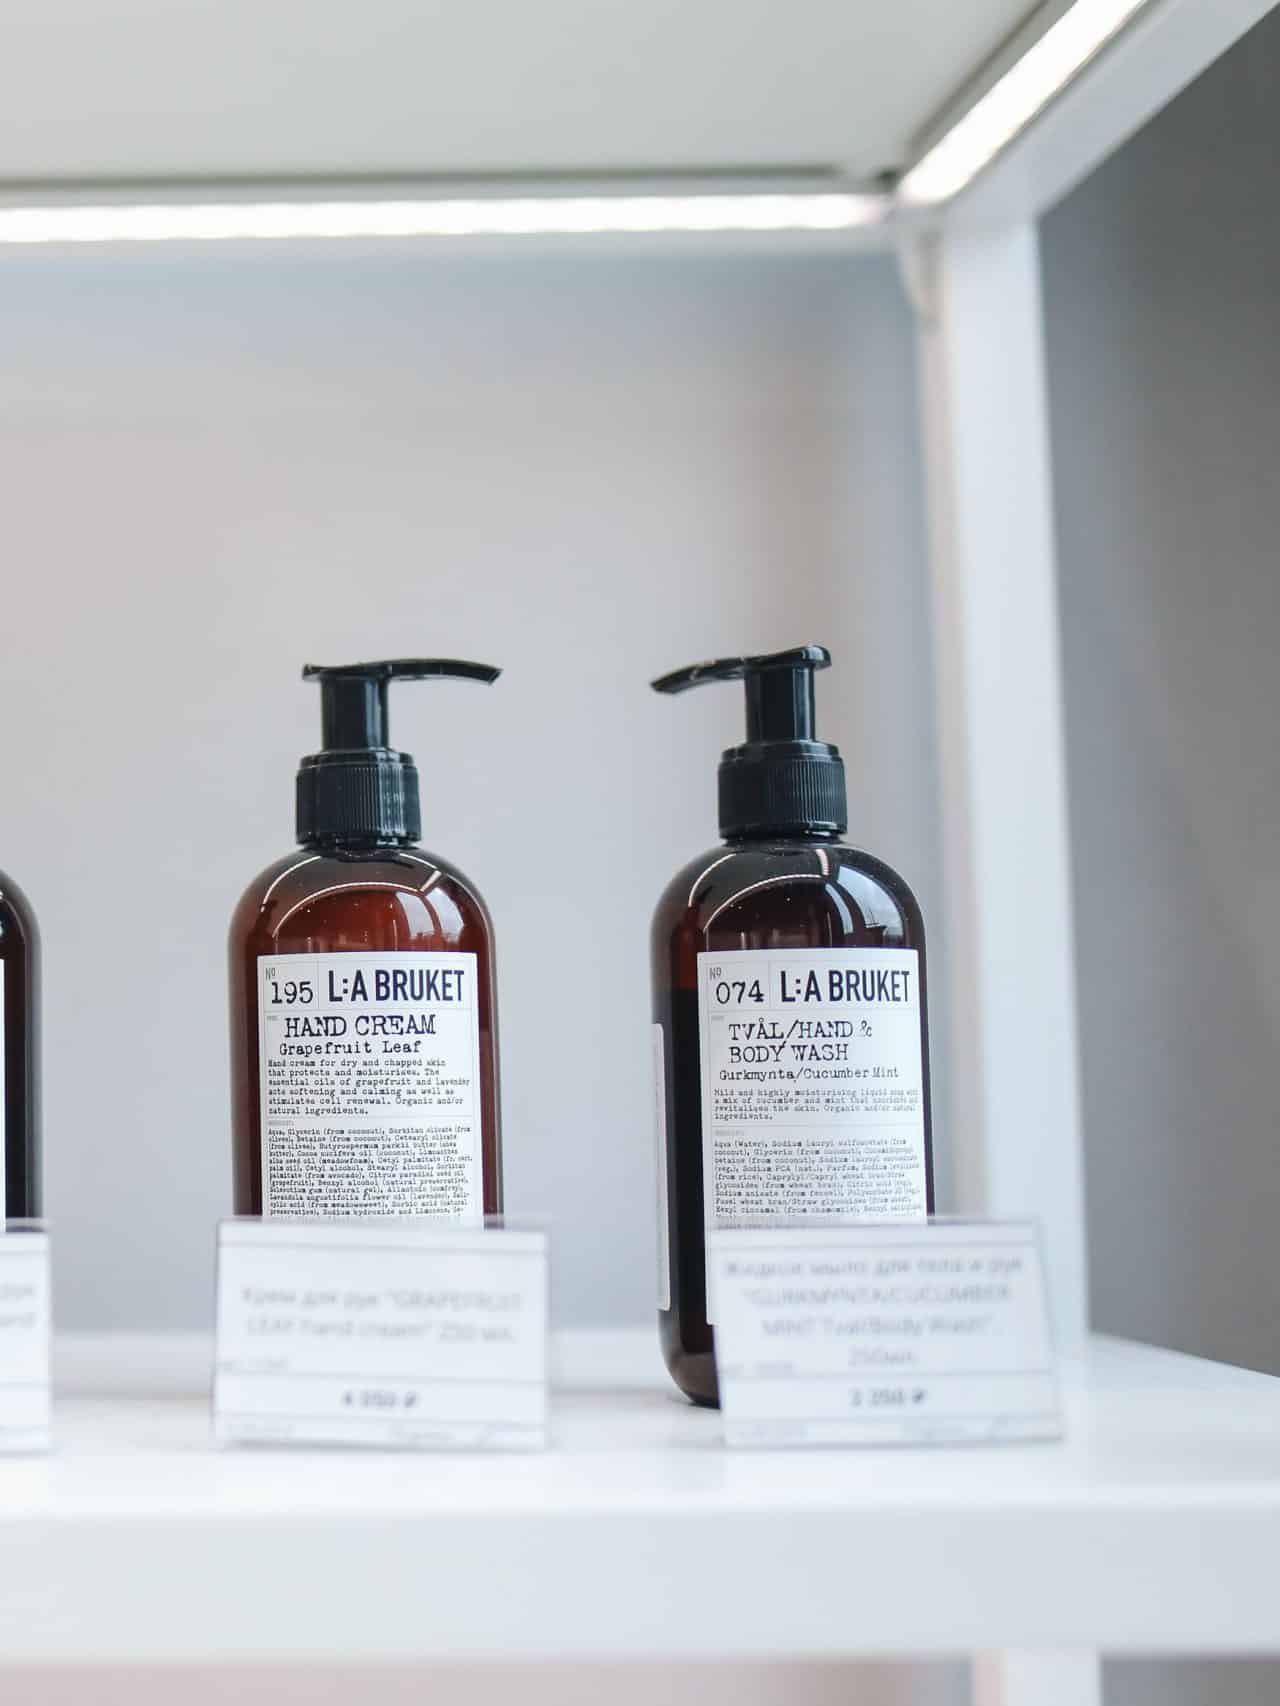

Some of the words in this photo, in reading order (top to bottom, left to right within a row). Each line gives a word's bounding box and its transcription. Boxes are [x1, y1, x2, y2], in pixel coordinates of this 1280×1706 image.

[271, 981, 314, 1004] 195
[328, 969, 368, 1002] L:A
[375, 968, 465, 1002] BRUKET
[715, 980, 765, 1004] 074
[780, 970, 822, 1002] L:A
[828, 969, 910, 1002] BRUKET
[284, 1016, 347, 1038] HAND
[355, 1014, 436, 1036] CREAM
[728, 1017, 854, 1041] TVÅL/HAND
[279, 1041, 372, 1057] Grapefruit
[382, 1040, 422, 1054] Leaf
[728, 1045, 786, 1063] BODY
[791, 1043, 849, 1062] WASH
[268, 1059, 286, 1067] Hand
[320, 1059, 336, 1067] for
[341, 1058, 357, 1068] dry
[362, 1058, 379, 1066] and
[384, 1058, 422, 1069] chapped
[427, 1058, 446, 1066] skin
[290, 1069, 330, 1079] protects
[334, 1068, 352, 1076] and
[356, 1068, 420, 1076] moisturises.
[424, 1067, 440, 1076] The
[719, 1066, 869, 1083] Gurkmynta/Cucumber
[872, 1066, 899, 1078] Mint
[313, 1077, 335, 1086] oils
[339, 1077, 351, 1086] of
[355, 1077, 411, 1090] grapefruit
[416, 1078, 432, 1086] and
[289, 1087, 336, 1097] softening
[340, 1087, 357, 1095] and
[362, 1087, 402, 1097] calming
[421, 1087, 440, 1095] well
[714, 1088, 734, 1096] Mild
[738, 1088, 753, 1096] and
[758, 1088, 790, 1098] highly
[268, 1096, 315, 1104] stimulates
[319, 1096, 341, 1104] cell
[345, 1096, 391, 1104] renewal.
[395, 1096, 433, 1107] Organic
[437, 1096, 464, 1105] and/or
[742, 1096, 752, 1104] of
[268, 1106, 301, 1114] natural
[304, 1106, 369, 1116] ingredients.
[773, 1104, 789, 1112] the
[794, 1104, 820, 1112] skin.
